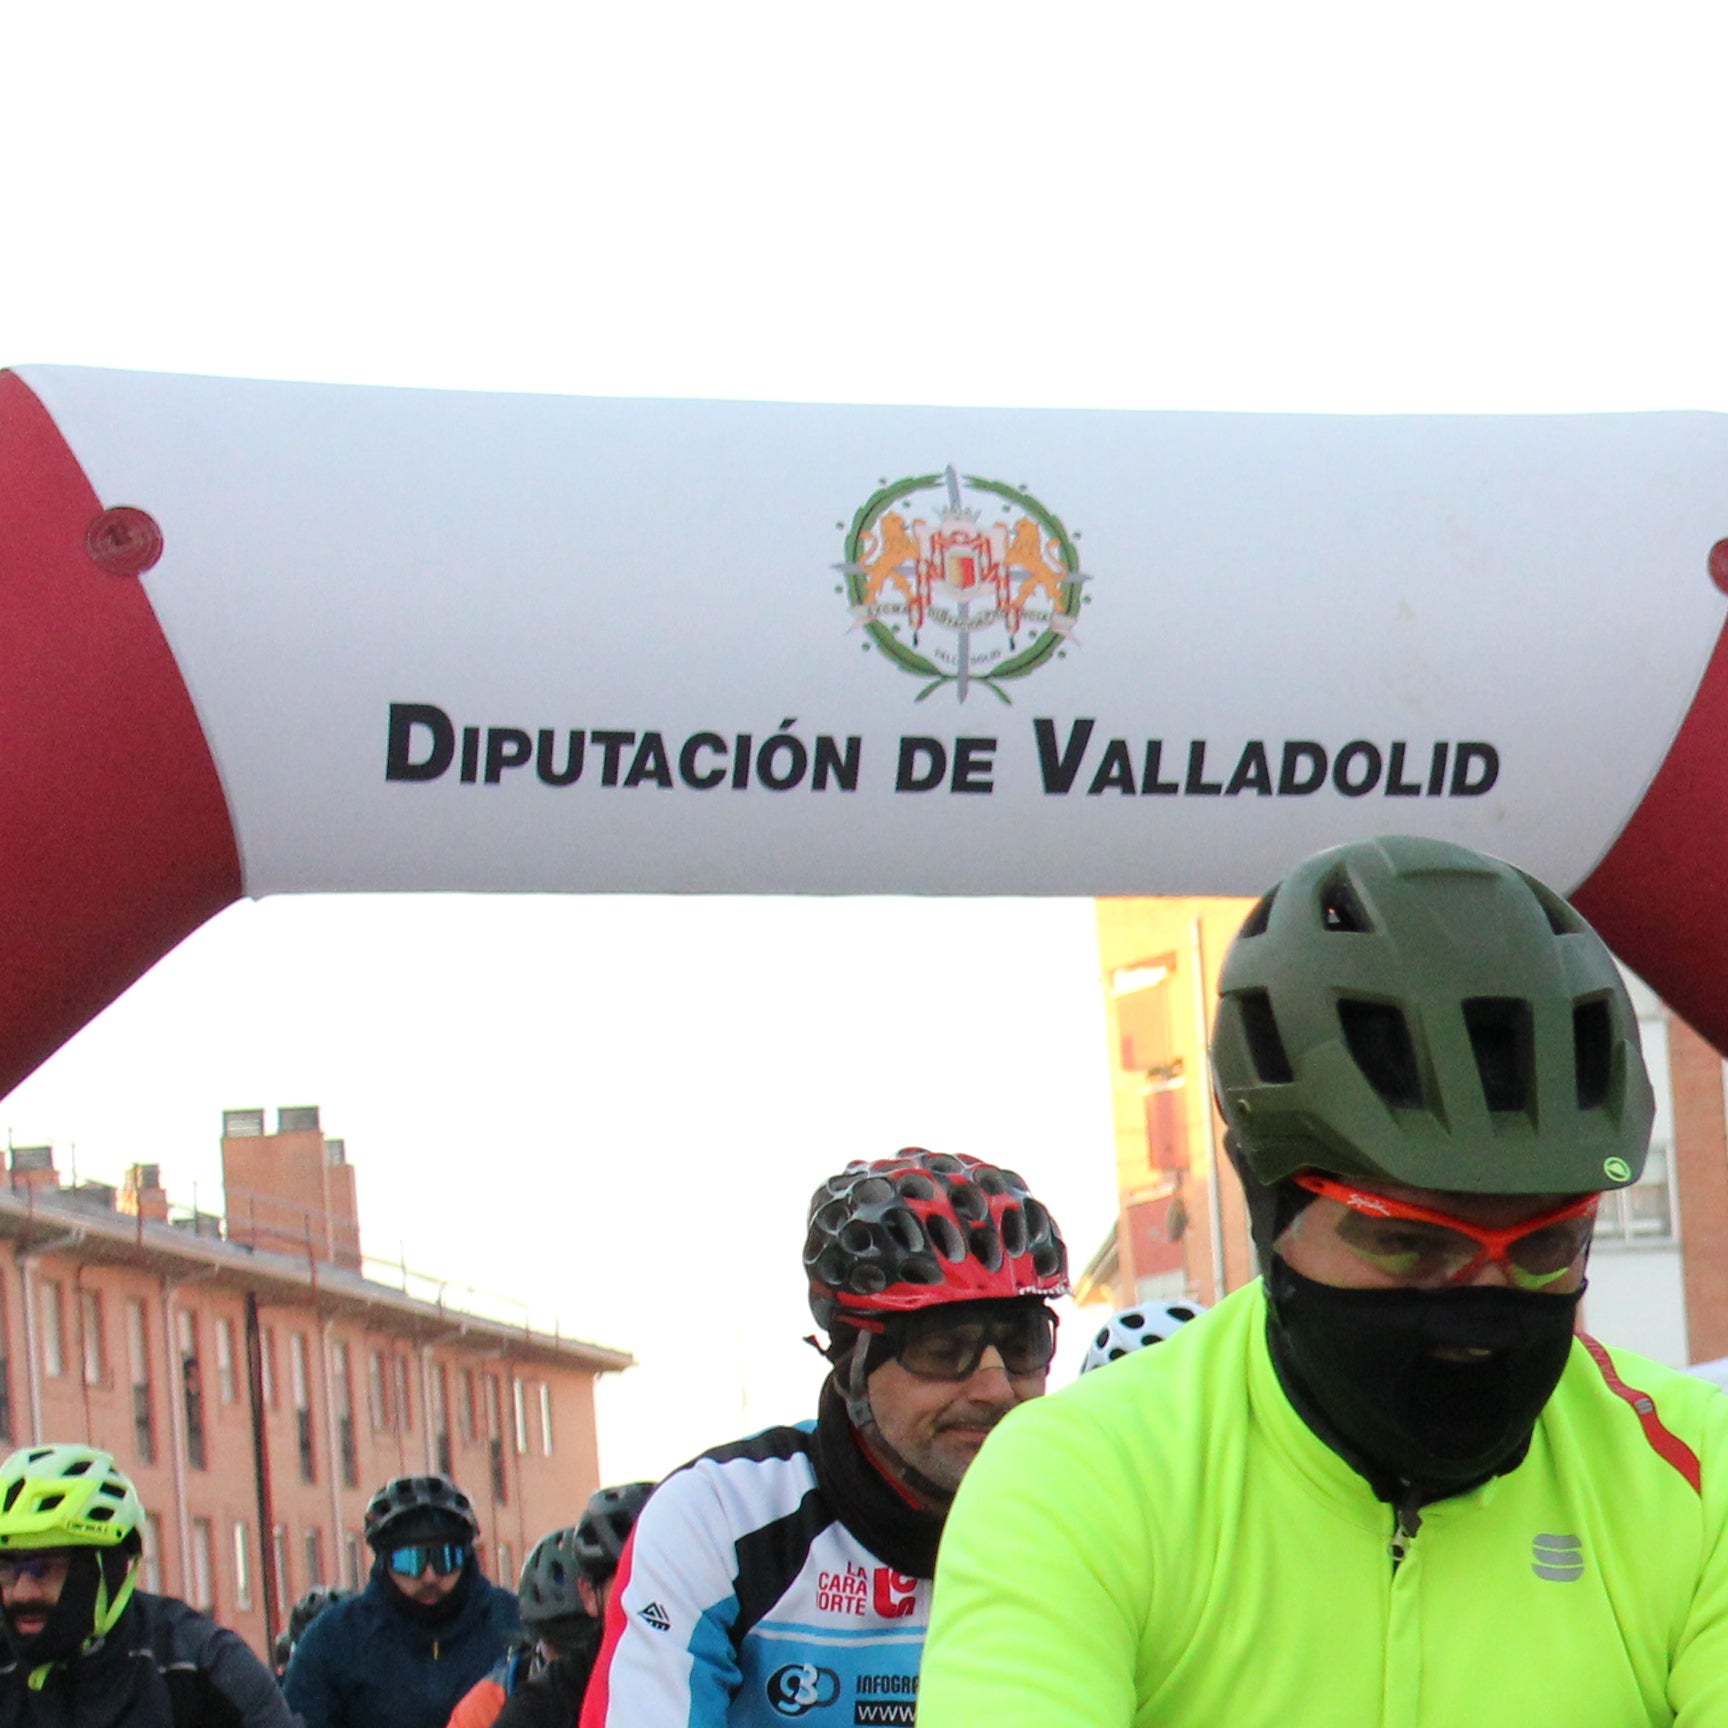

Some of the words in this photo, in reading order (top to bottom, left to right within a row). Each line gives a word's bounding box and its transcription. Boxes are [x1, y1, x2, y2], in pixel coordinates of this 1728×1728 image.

[384, 702, 863, 792] DIPUTACIÓN
[894, 734, 1000, 794] DE
[1032, 717, 1502, 799] VALLADOLID
[847, 1560, 867, 1580] LA
[818, 1571, 867, 1596] CARA
